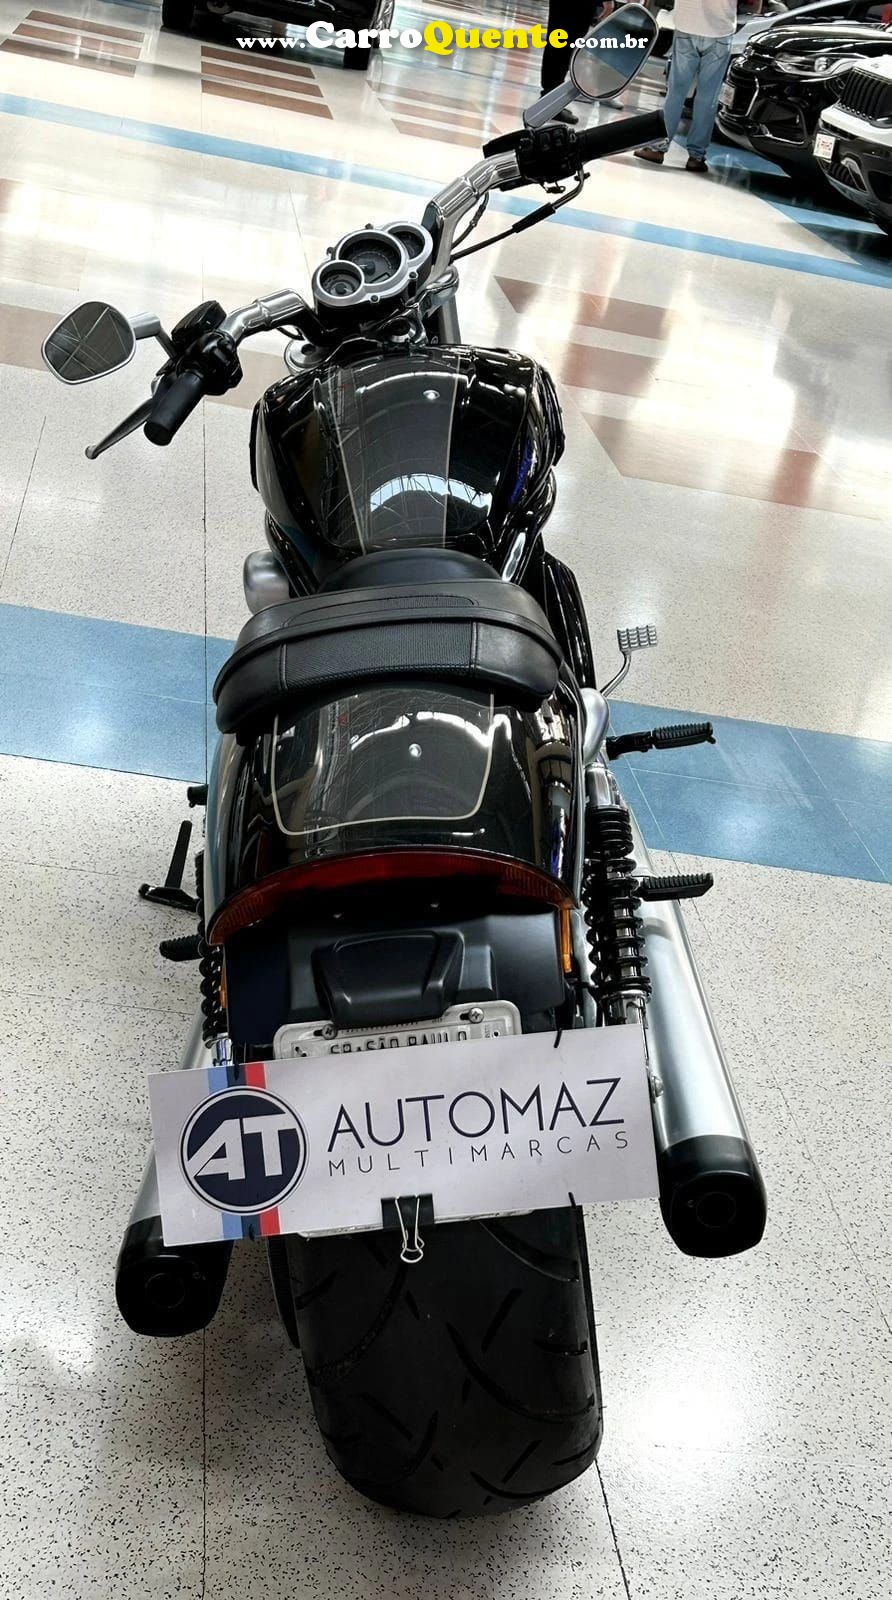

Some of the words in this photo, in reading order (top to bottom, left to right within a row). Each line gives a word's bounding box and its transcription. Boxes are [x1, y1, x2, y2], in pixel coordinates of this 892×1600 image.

[187, 1113, 298, 1181] AT
[327, 1077, 624, 1153] AUTOMAZ
[328, 1131, 629, 1177] MULTIMARCAS
